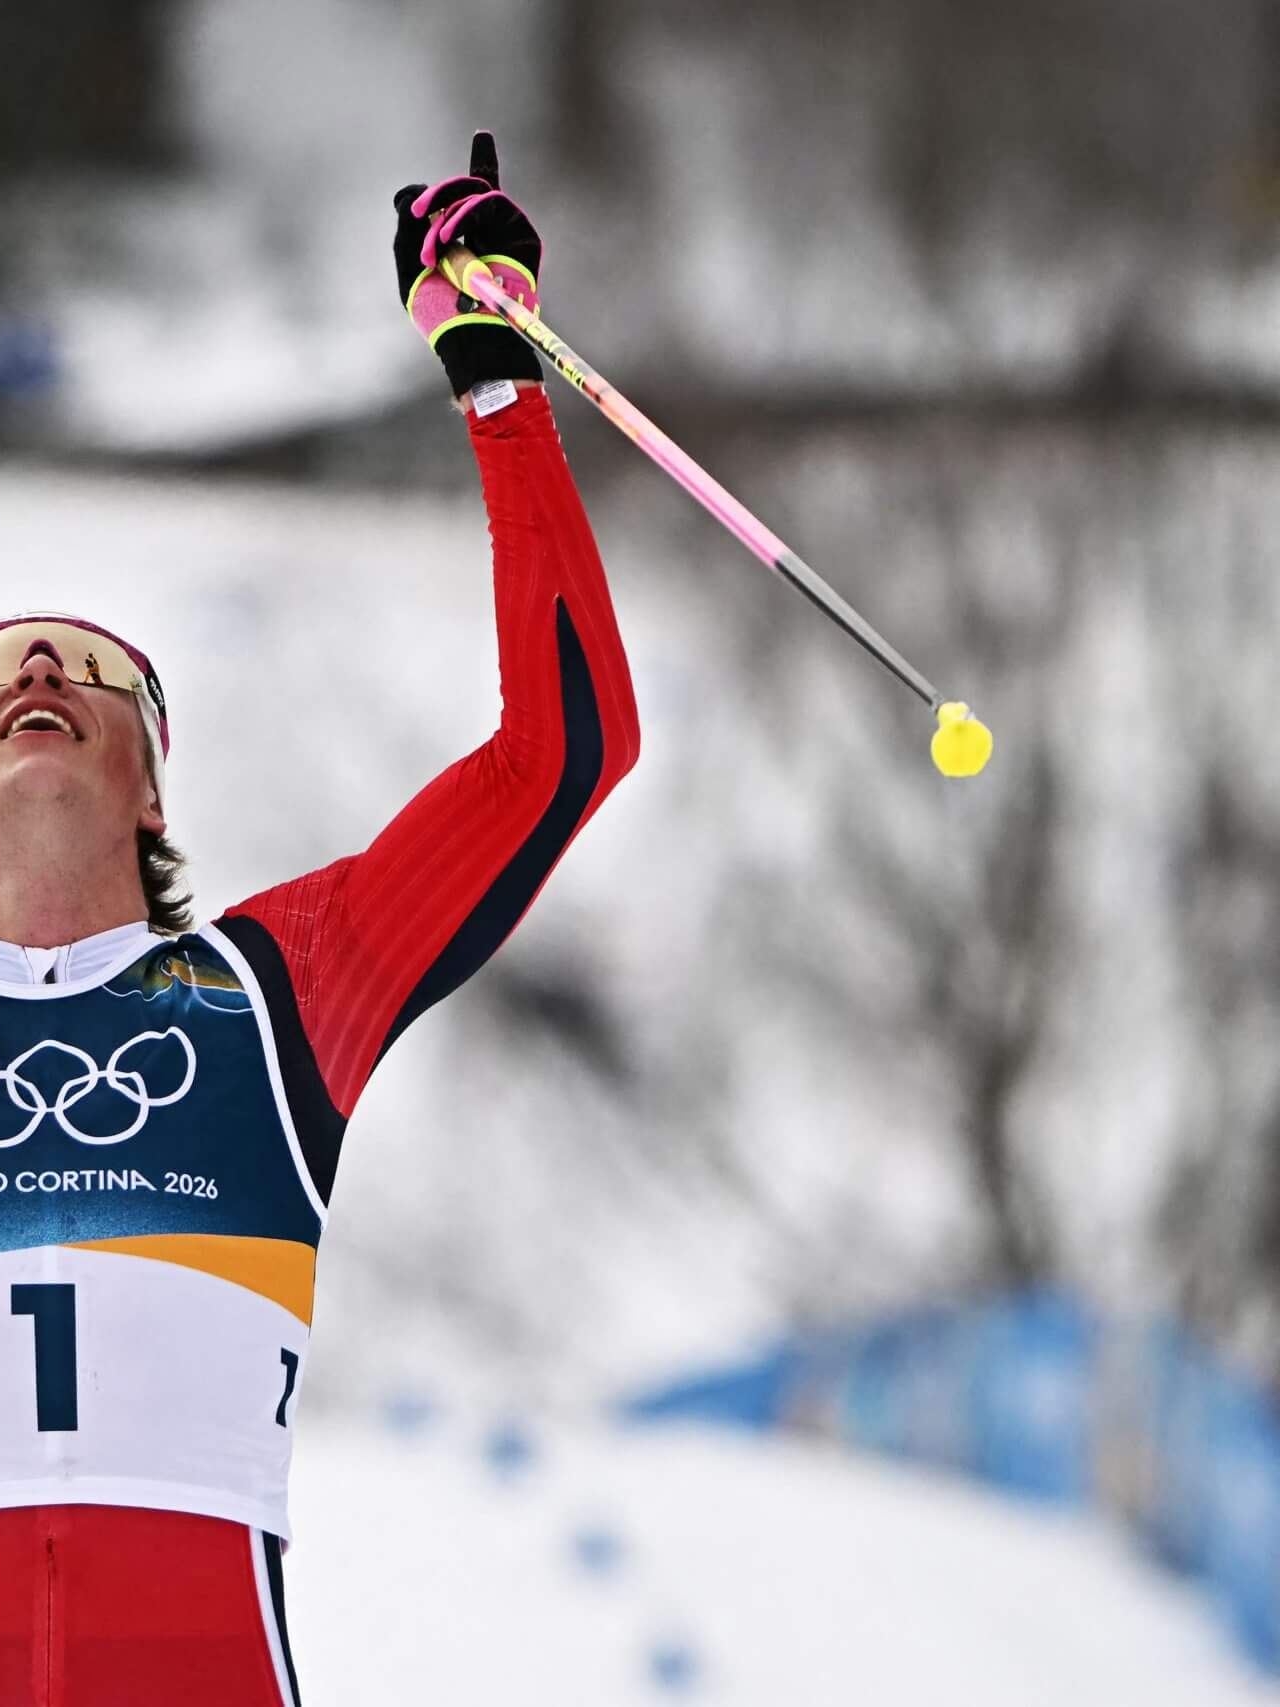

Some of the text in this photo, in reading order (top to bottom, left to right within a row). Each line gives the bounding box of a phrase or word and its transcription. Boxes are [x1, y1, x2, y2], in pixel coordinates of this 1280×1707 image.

[15, 1169, 157, 1193] CORTINA
[164, 1172, 219, 1200] 2026
[11, 1284, 78, 1432] 1
